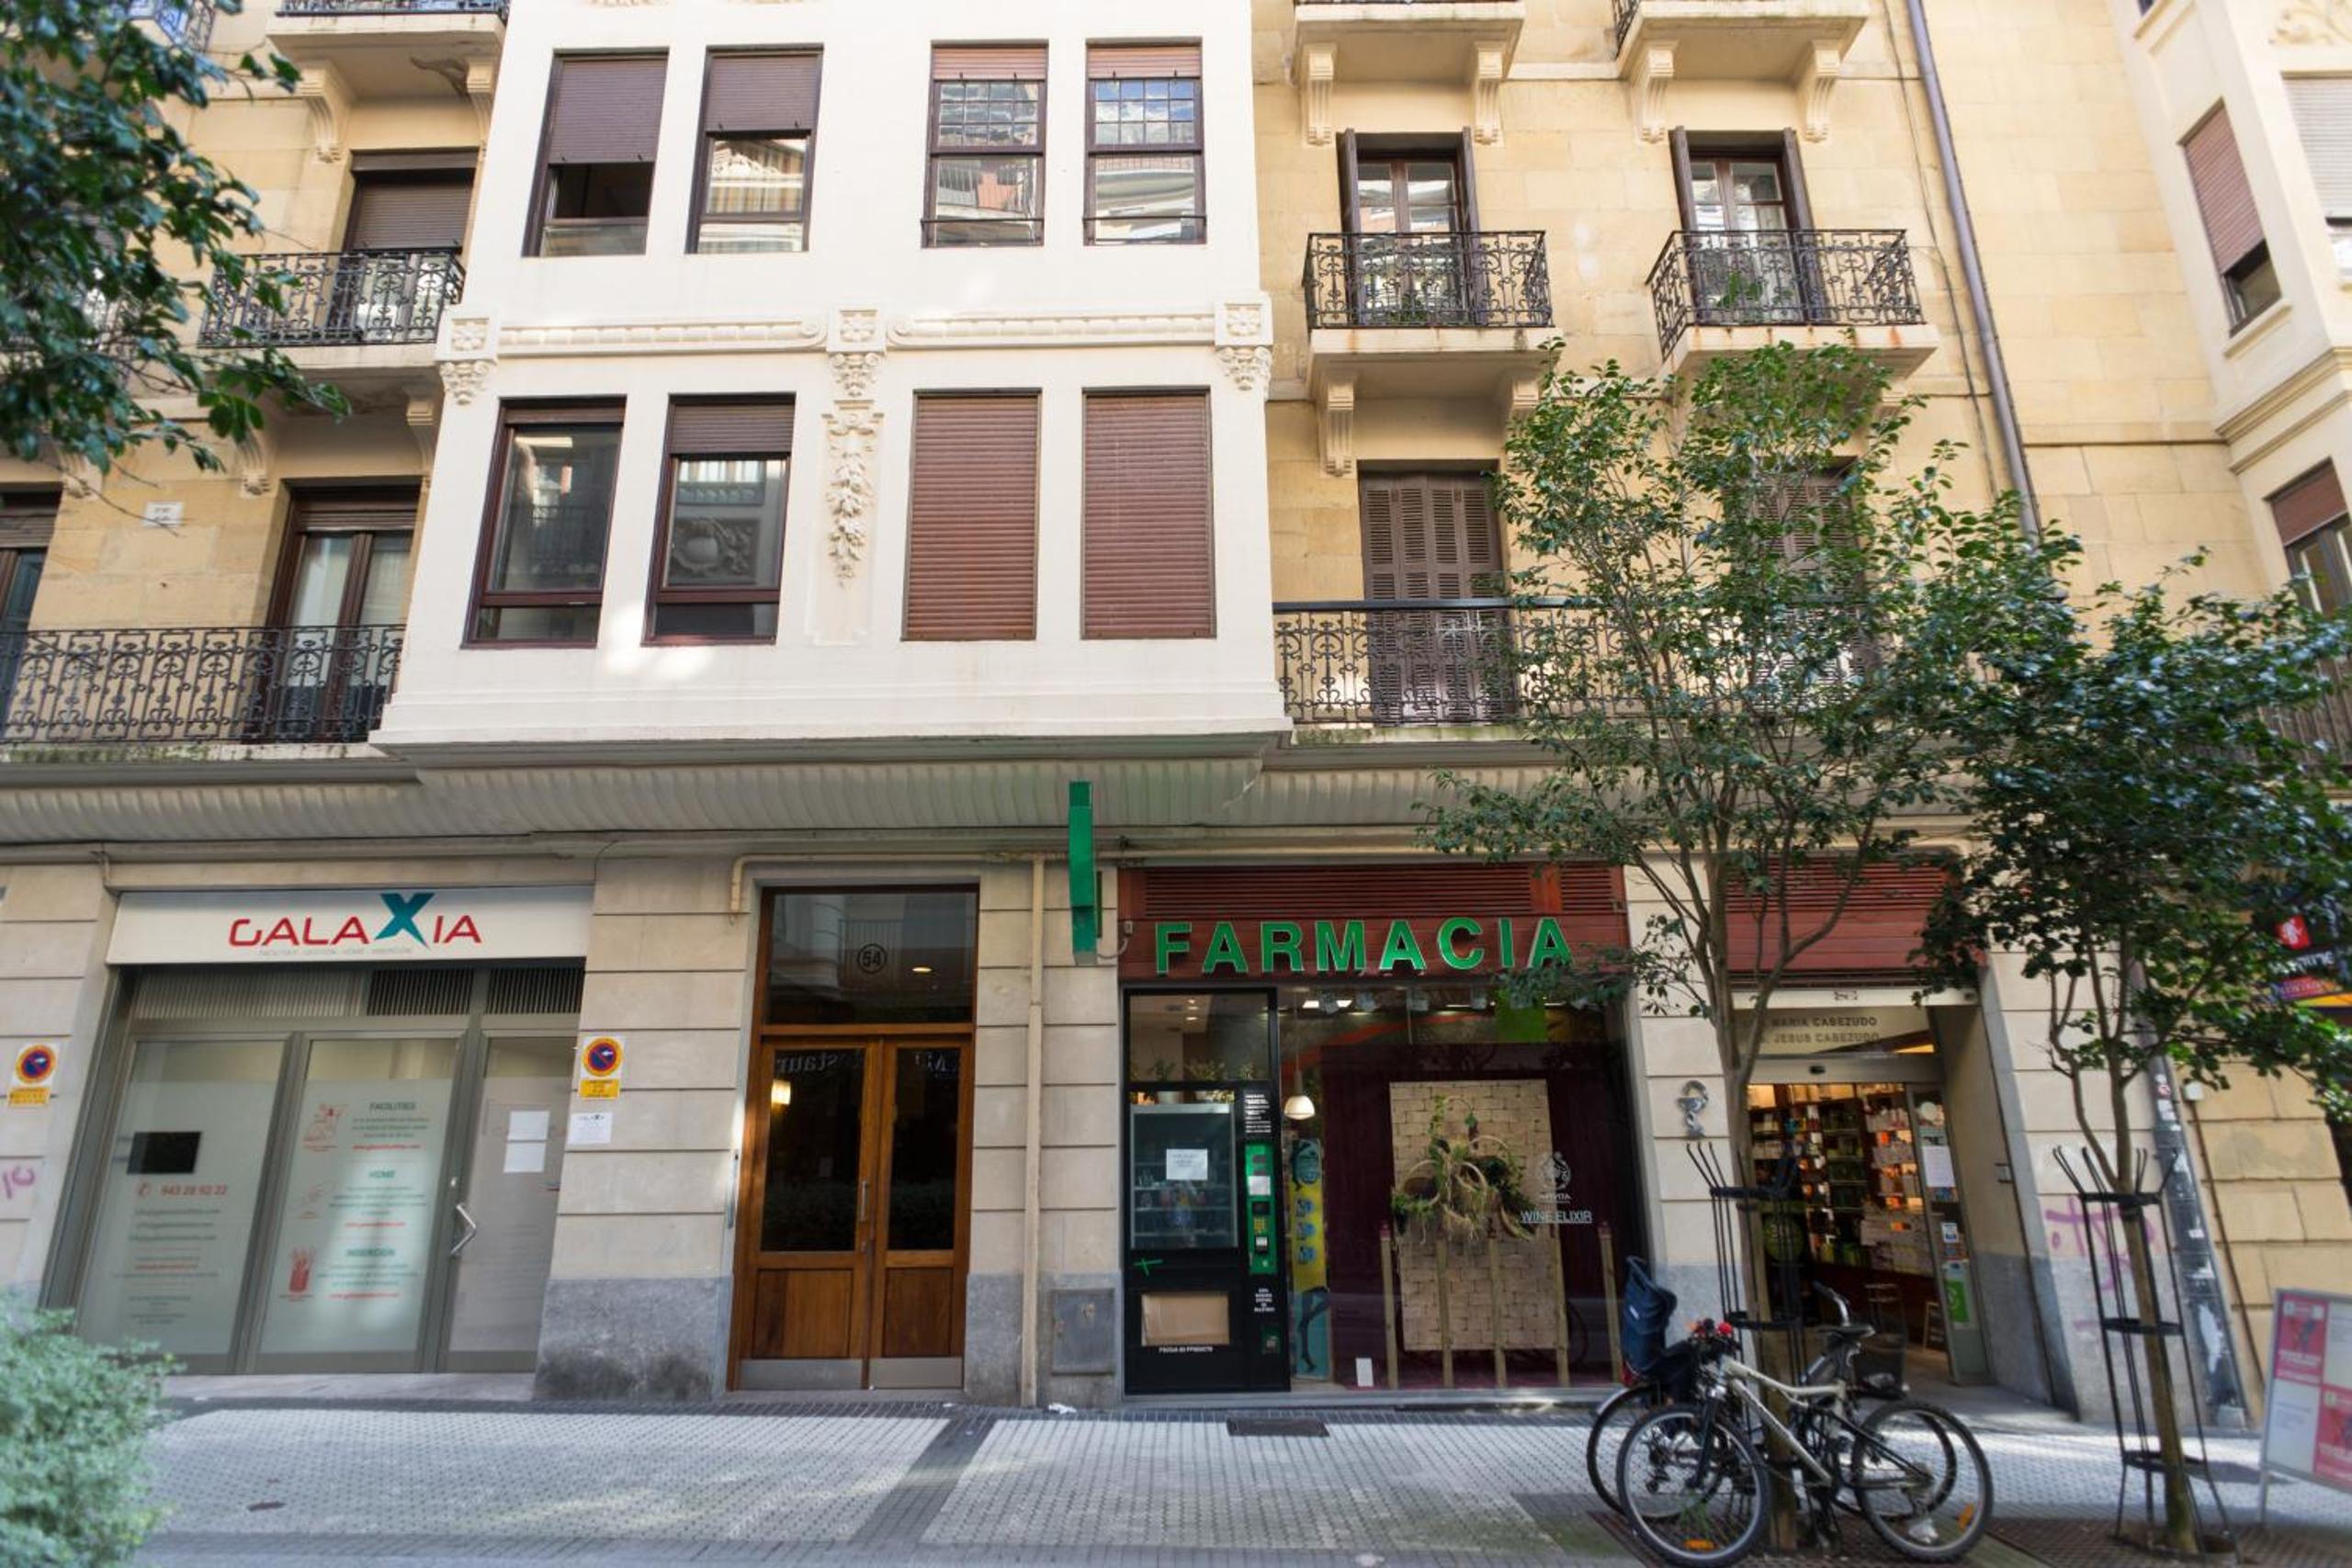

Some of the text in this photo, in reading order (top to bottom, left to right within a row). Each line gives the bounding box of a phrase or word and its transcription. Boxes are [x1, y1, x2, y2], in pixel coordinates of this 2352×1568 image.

[229, 893, 482, 949] GALAXIA
[1155, 917, 1574, 974] FARMACIA
[1521, 1210, 1593, 1223] WINE ELIXIR
